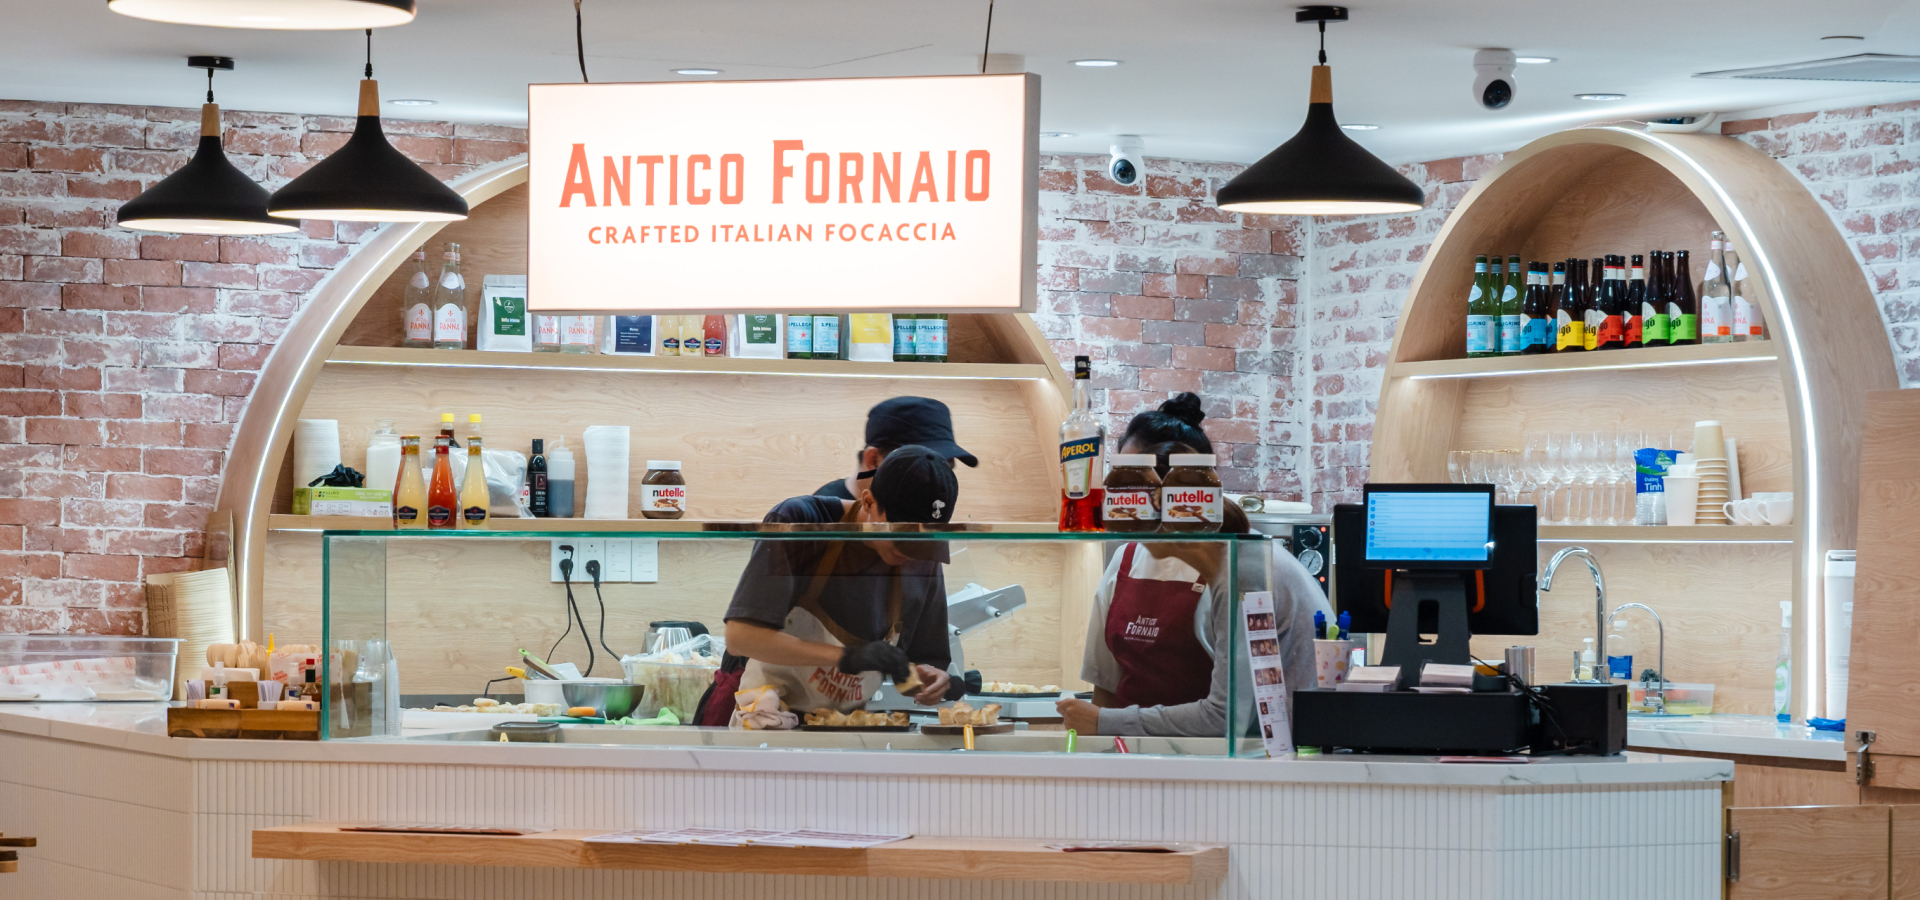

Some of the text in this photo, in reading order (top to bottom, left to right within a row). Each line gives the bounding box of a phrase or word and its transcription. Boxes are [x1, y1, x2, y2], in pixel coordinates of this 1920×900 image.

[559, 140, 990, 207] ANTICO FORNAIO
[589, 223, 956, 244] CRAFTED ITALIAN FOCACCIA
[410, 321, 430, 330] PANNA
[439, 322, 460, 330] PANNA
[1061, 443, 1095, 459] APEROL
[653, 488, 685, 497] nutella
[1167, 490, 1213, 503] nutella
[1107, 494, 1147, 505] nutella
[1125, 621, 1160, 637] FORNAIO
